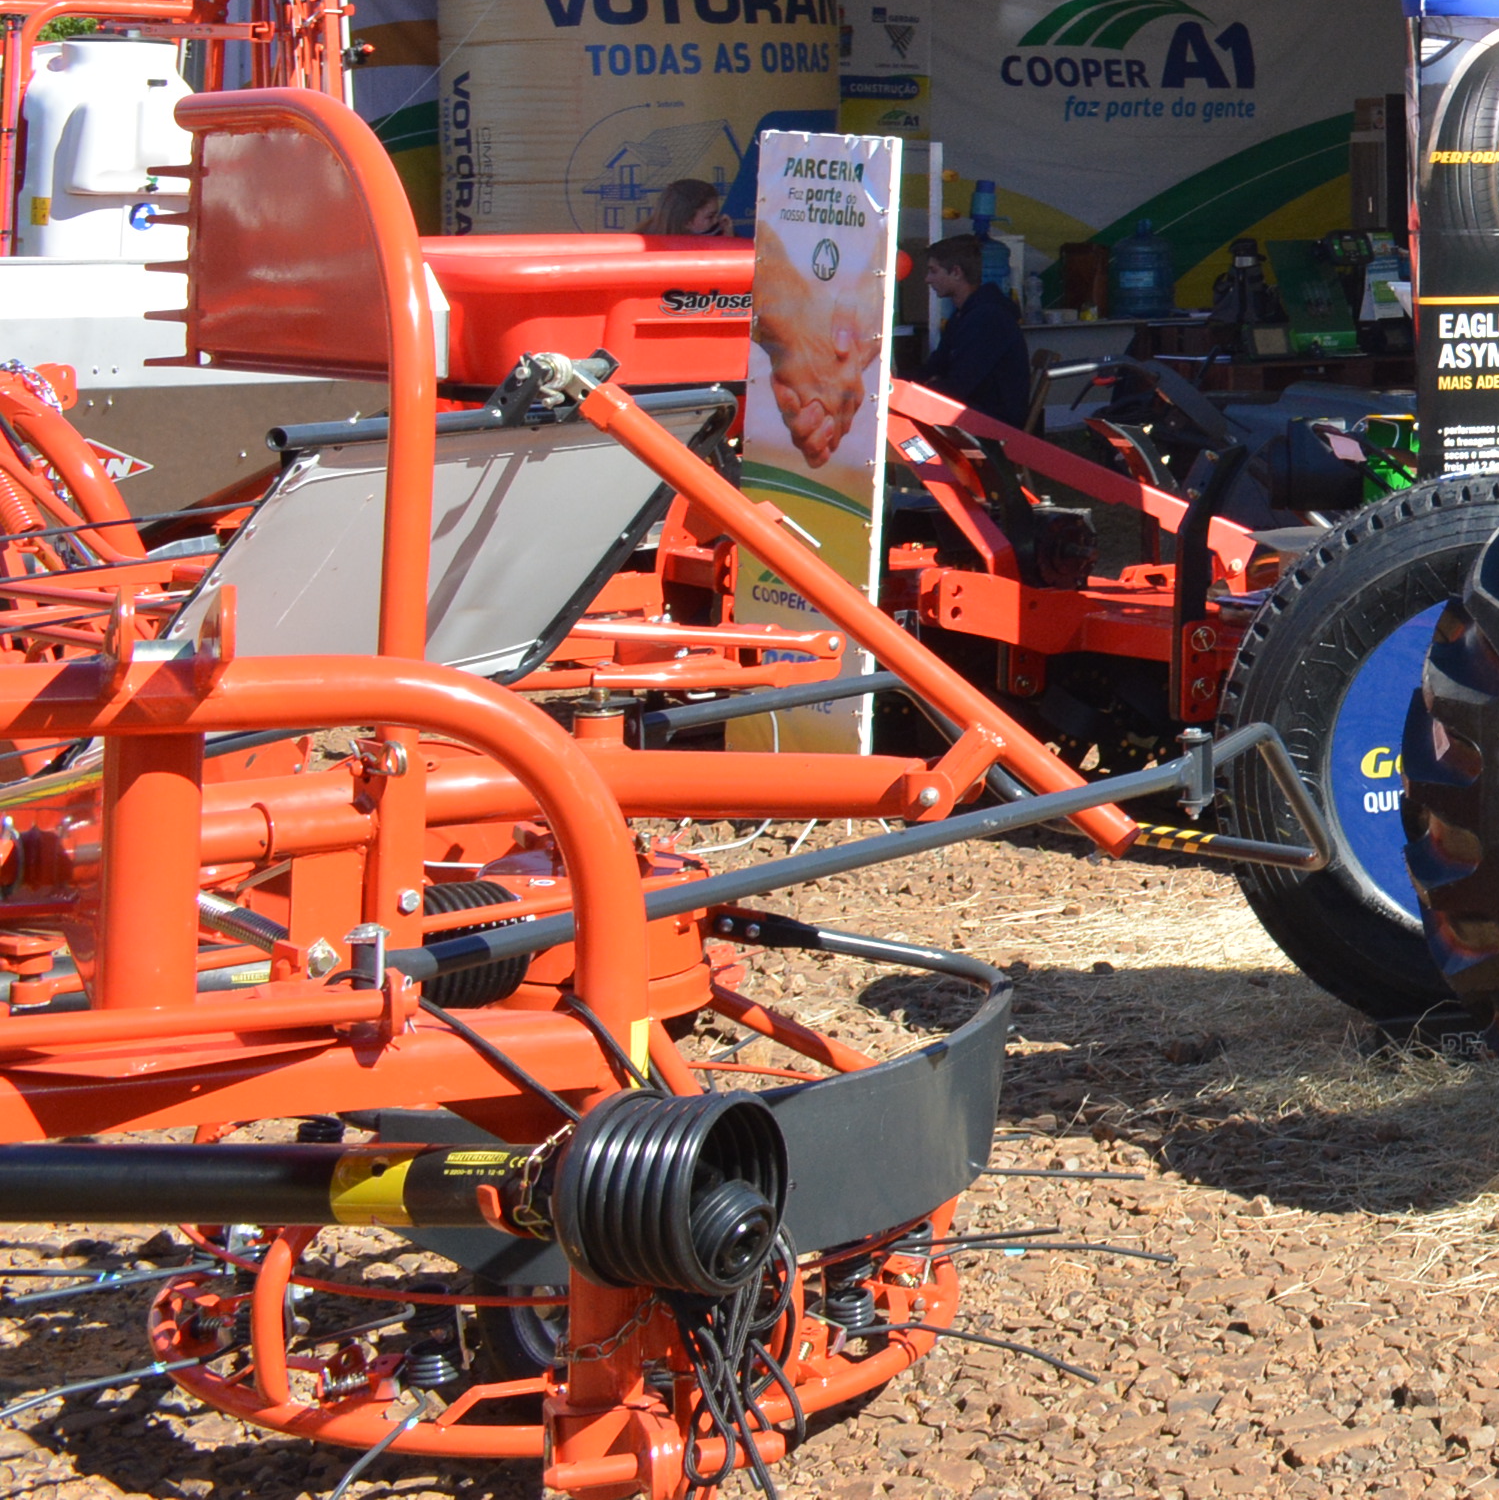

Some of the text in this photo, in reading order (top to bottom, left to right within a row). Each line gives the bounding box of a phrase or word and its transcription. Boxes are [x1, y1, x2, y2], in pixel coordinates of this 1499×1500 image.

[585, 41, 830, 77] TODAS AS OBRAS
[1001, 21, 1256, 89] COOPER A1
[849, 83, 918, 97] CONSTRUÇÃO
[1064, 96, 1256, 123] faz parte da gente
[784, 157, 865, 183] PARCERIA
[805, 187, 842, 204] parte
[780, 203, 866, 228] nosso trabalho
[1438, 375, 1473, 390] MAIS
[752, 584, 807, 612] COOPER
